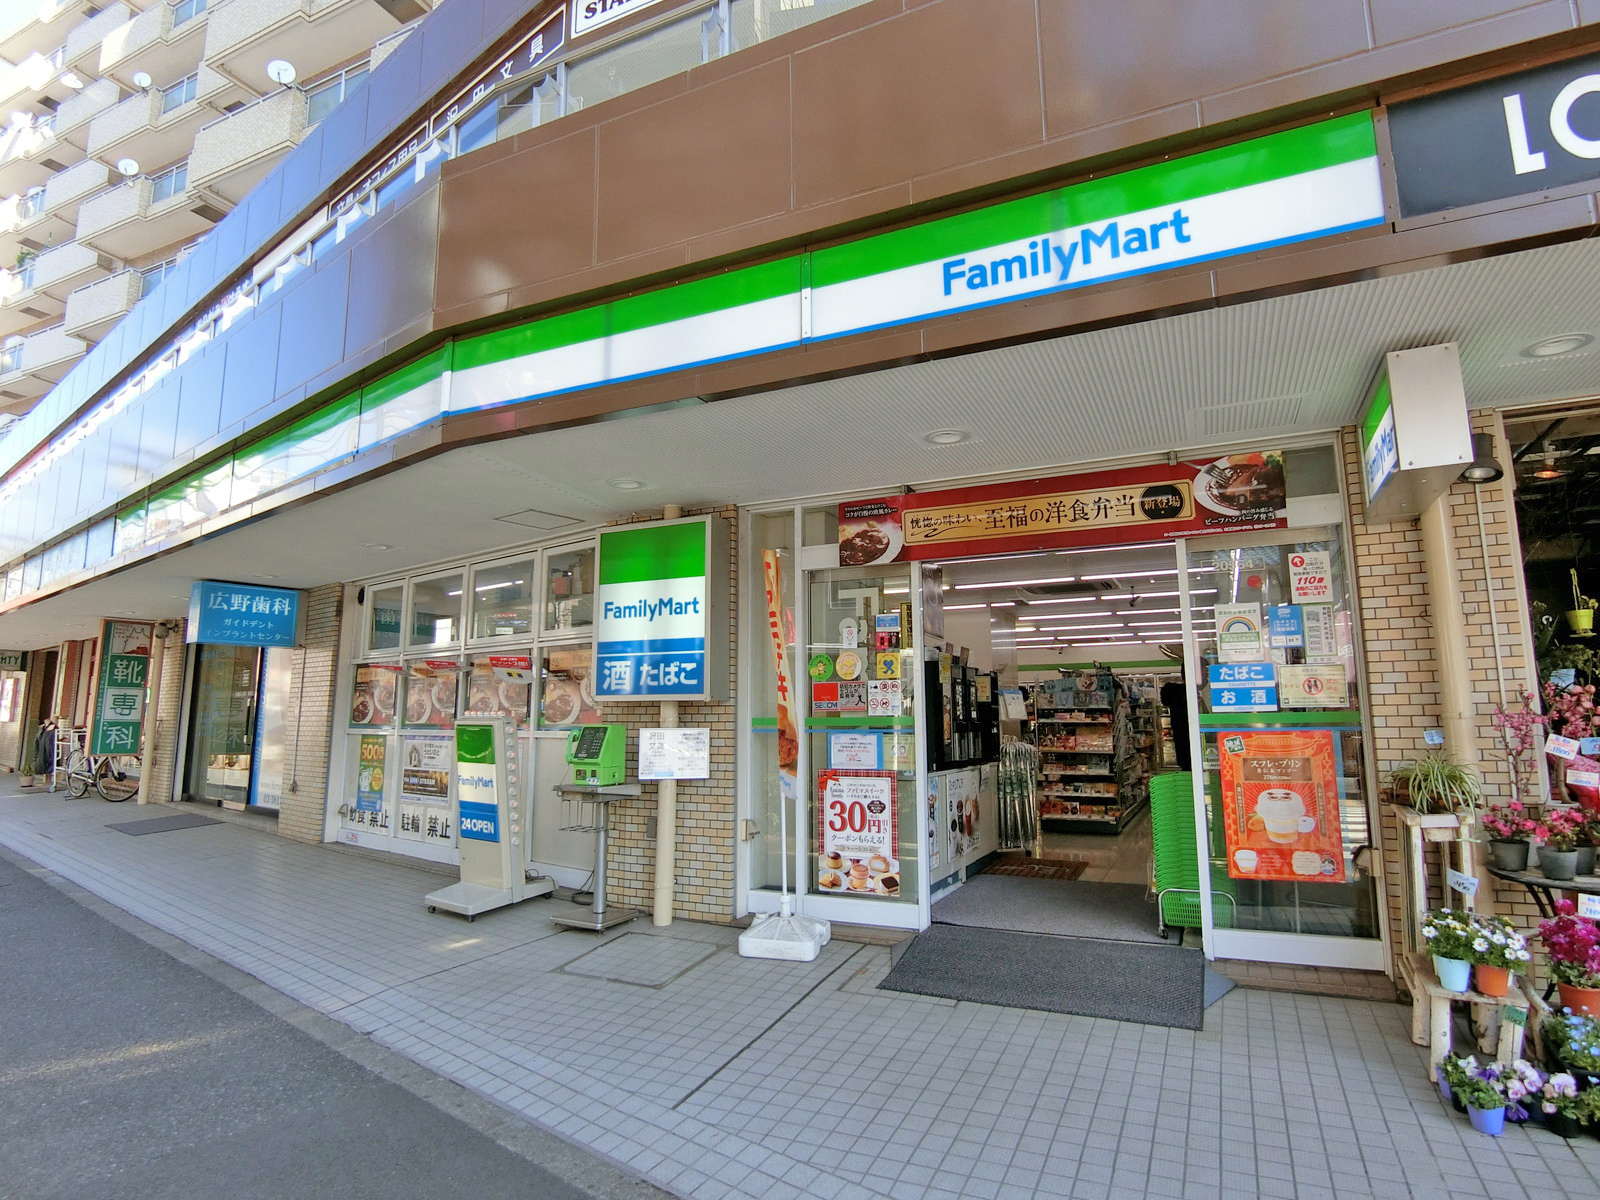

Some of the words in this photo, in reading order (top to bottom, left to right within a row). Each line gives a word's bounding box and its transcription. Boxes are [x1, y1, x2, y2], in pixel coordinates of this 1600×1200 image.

[941, 208, 1192, 297] FamilyMart
[1364, 423, 1395, 499] FamilyMar
[1143, 495, 1181, 511] 新登場
[208, 591, 292, 615] 広野歯科
[603, 596, 700, 622] FamilyMart
[223, 618, 275, 629] ガイドデント
[206, 628, 290, 641] インプラントセンター
[602, 660, 631, 691] 酒
[639, 662, 698, 687] たばこ
[1219, 665, 1265, 681] たばこ
[104, 659, 144, 750] 靴専科
[1250, 758, 1303, 768] スフレ・プリン
[457, 773, 495, 790] FamilyMart
[846, 787, 885, 795] ファミマスイーツ
[369, 809, 390, 829] 禁止
[401, 813, 420, 834] 駐輪
[427, 815, 451, 839] 禁止
[831, 833, 885, 845] クーポンもらえる!
